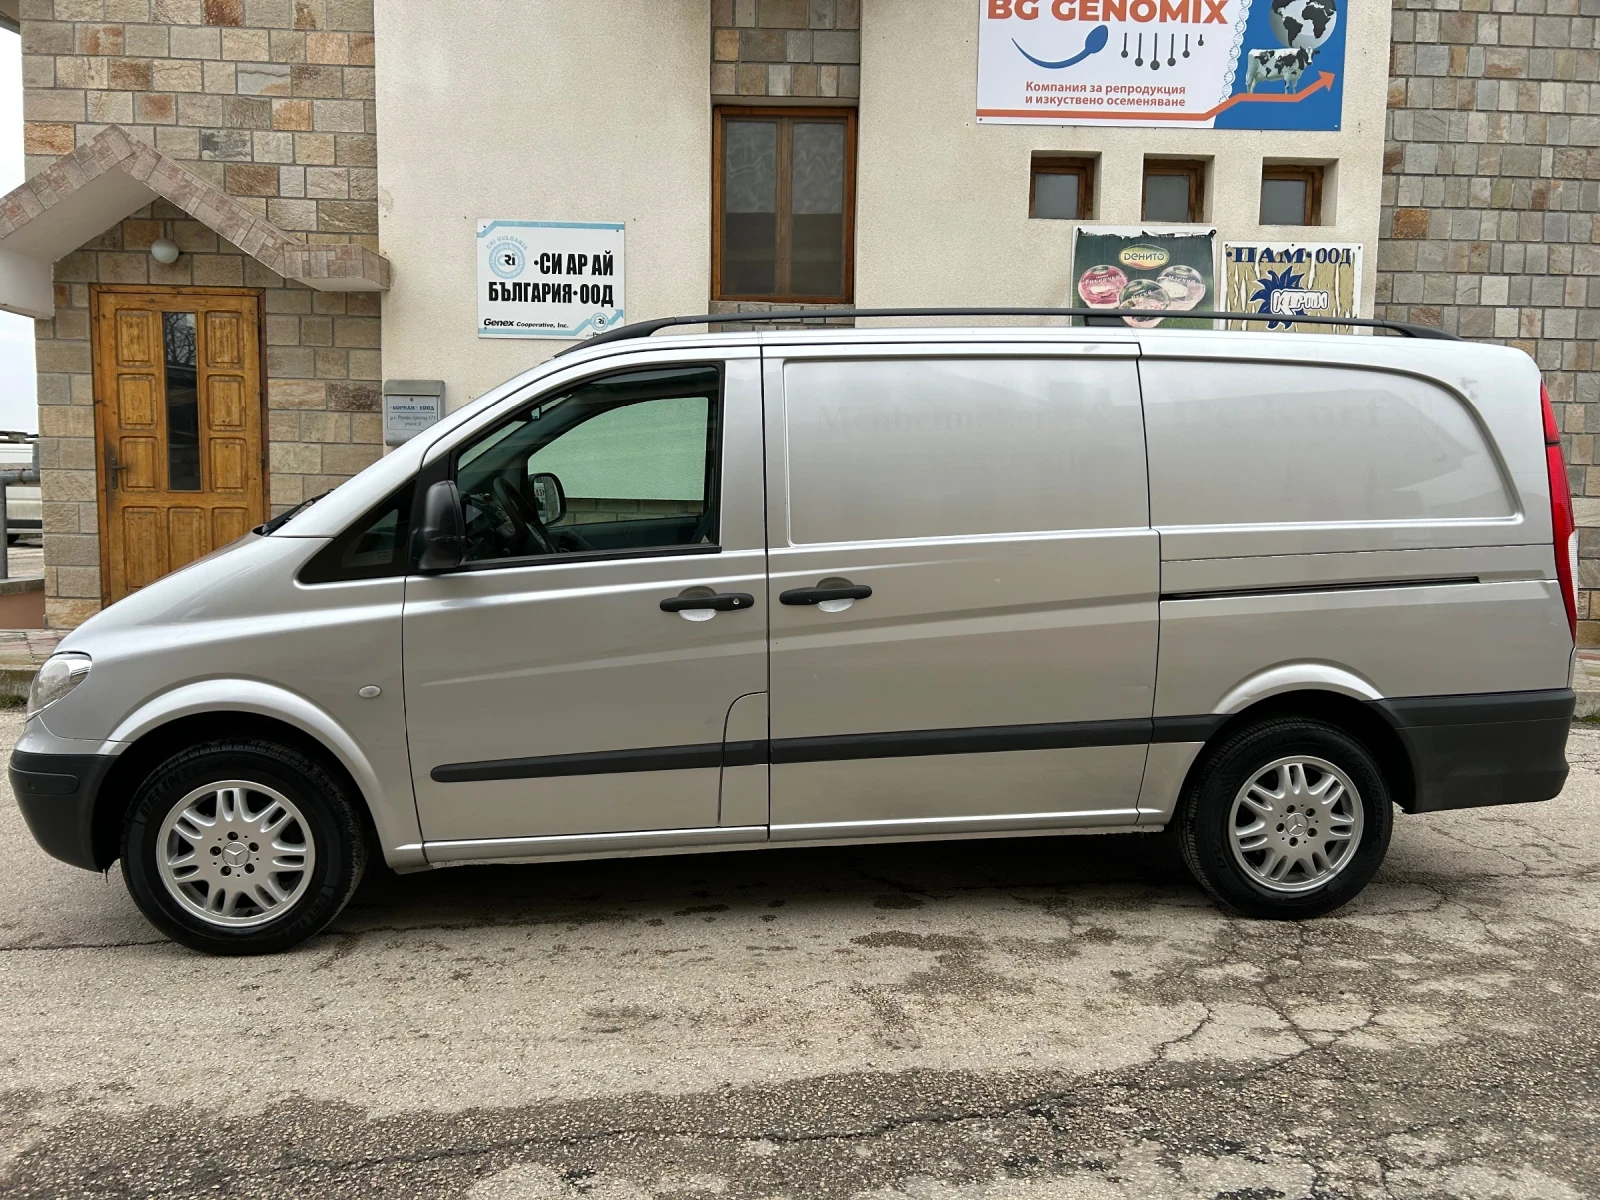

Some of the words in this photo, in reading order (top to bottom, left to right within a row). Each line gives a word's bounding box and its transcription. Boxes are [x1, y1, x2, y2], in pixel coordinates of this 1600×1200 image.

[988, 0, 1039, 20] BG
[1051, 0, 1228, 24] GENOMIX
[1025, 81, 1087, 93] Компания
[1089, 84, 1103, 94] за
[1105, 84, 1186, 96] репродукция
[1025, 96, 1033, 104] и
[1035, 96, 1104, 106] изкуствено
[1106, 97, 1186, 107] осеменяване
[566, 253, 588, 275] АР
[591, 250, 614, 276] АЙ
[1315, 247, 1352, 268] ООД
[483, 318, 515, 327] Genex
[516, 321, 556, 330] Cooperative,
